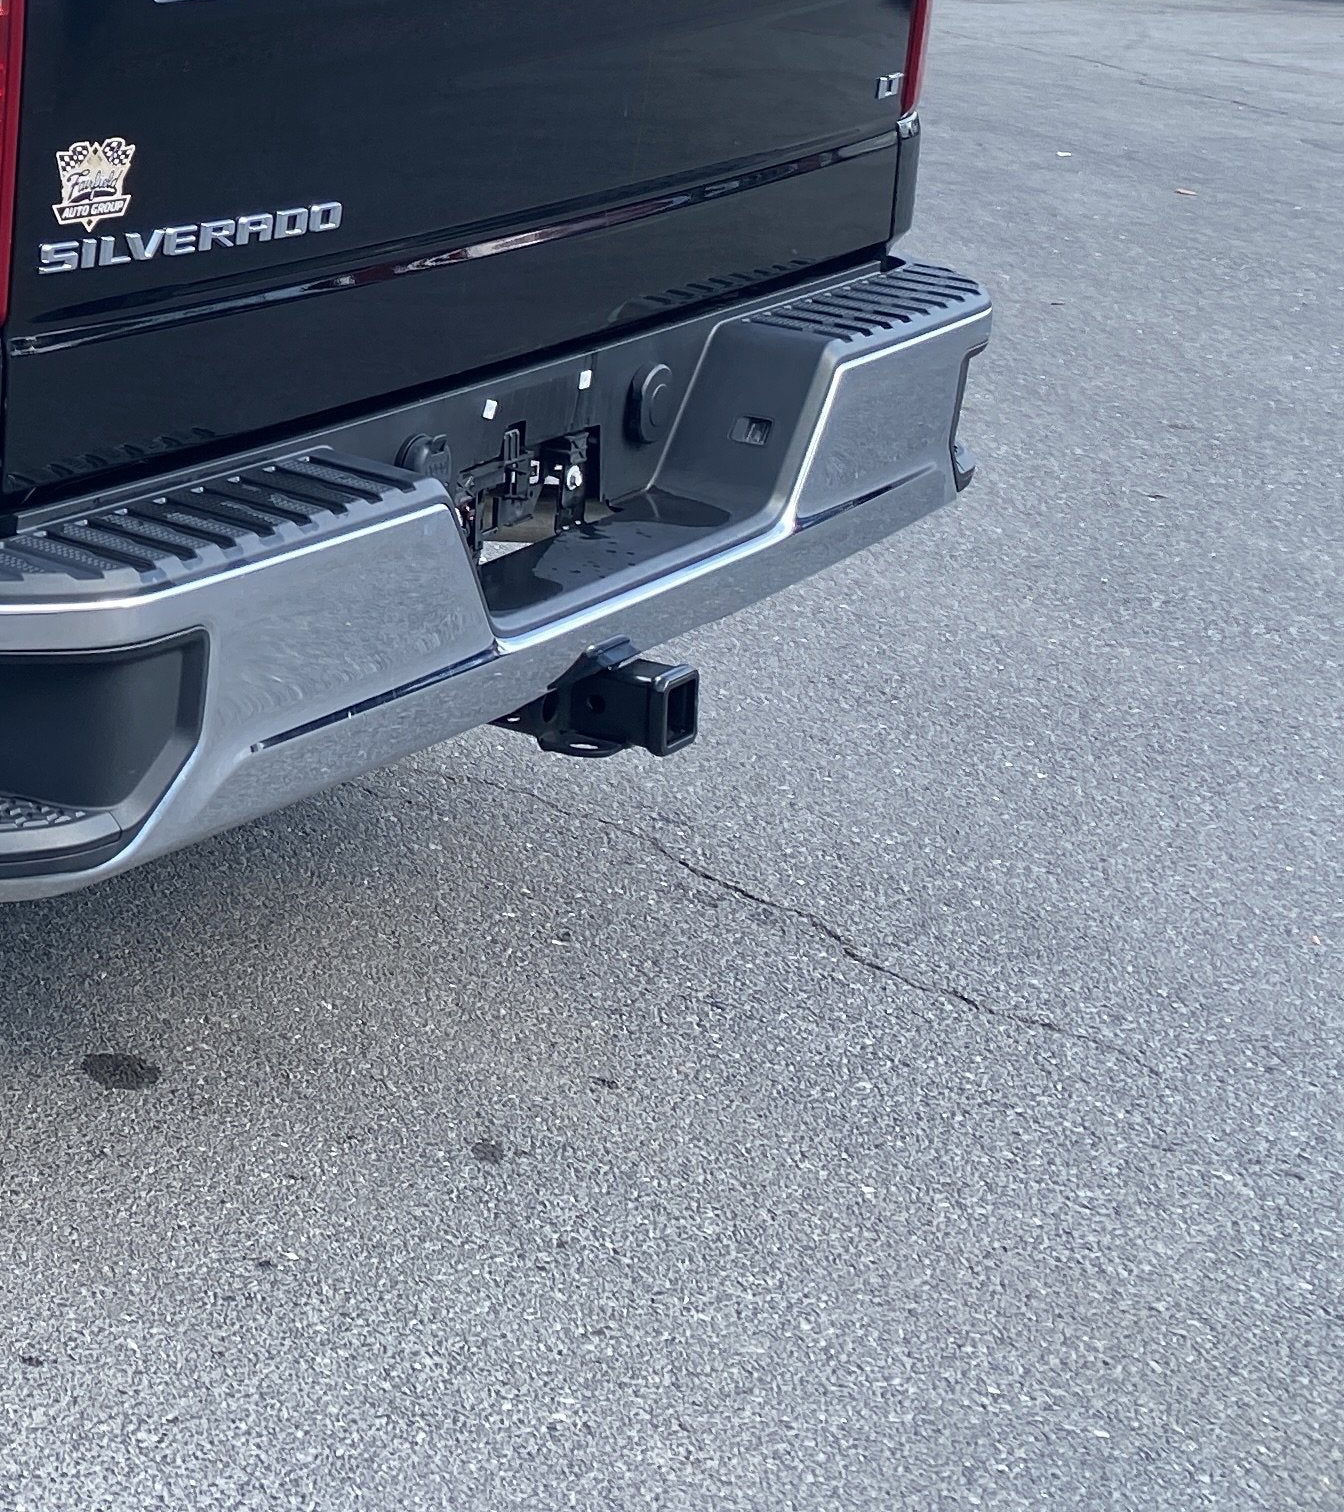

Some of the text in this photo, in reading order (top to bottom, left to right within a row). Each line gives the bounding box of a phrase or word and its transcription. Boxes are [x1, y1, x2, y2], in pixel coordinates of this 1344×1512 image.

[62, 200, 124, 219] AUTO GROUP
[38, 201, 343, 274] SILVERADO
